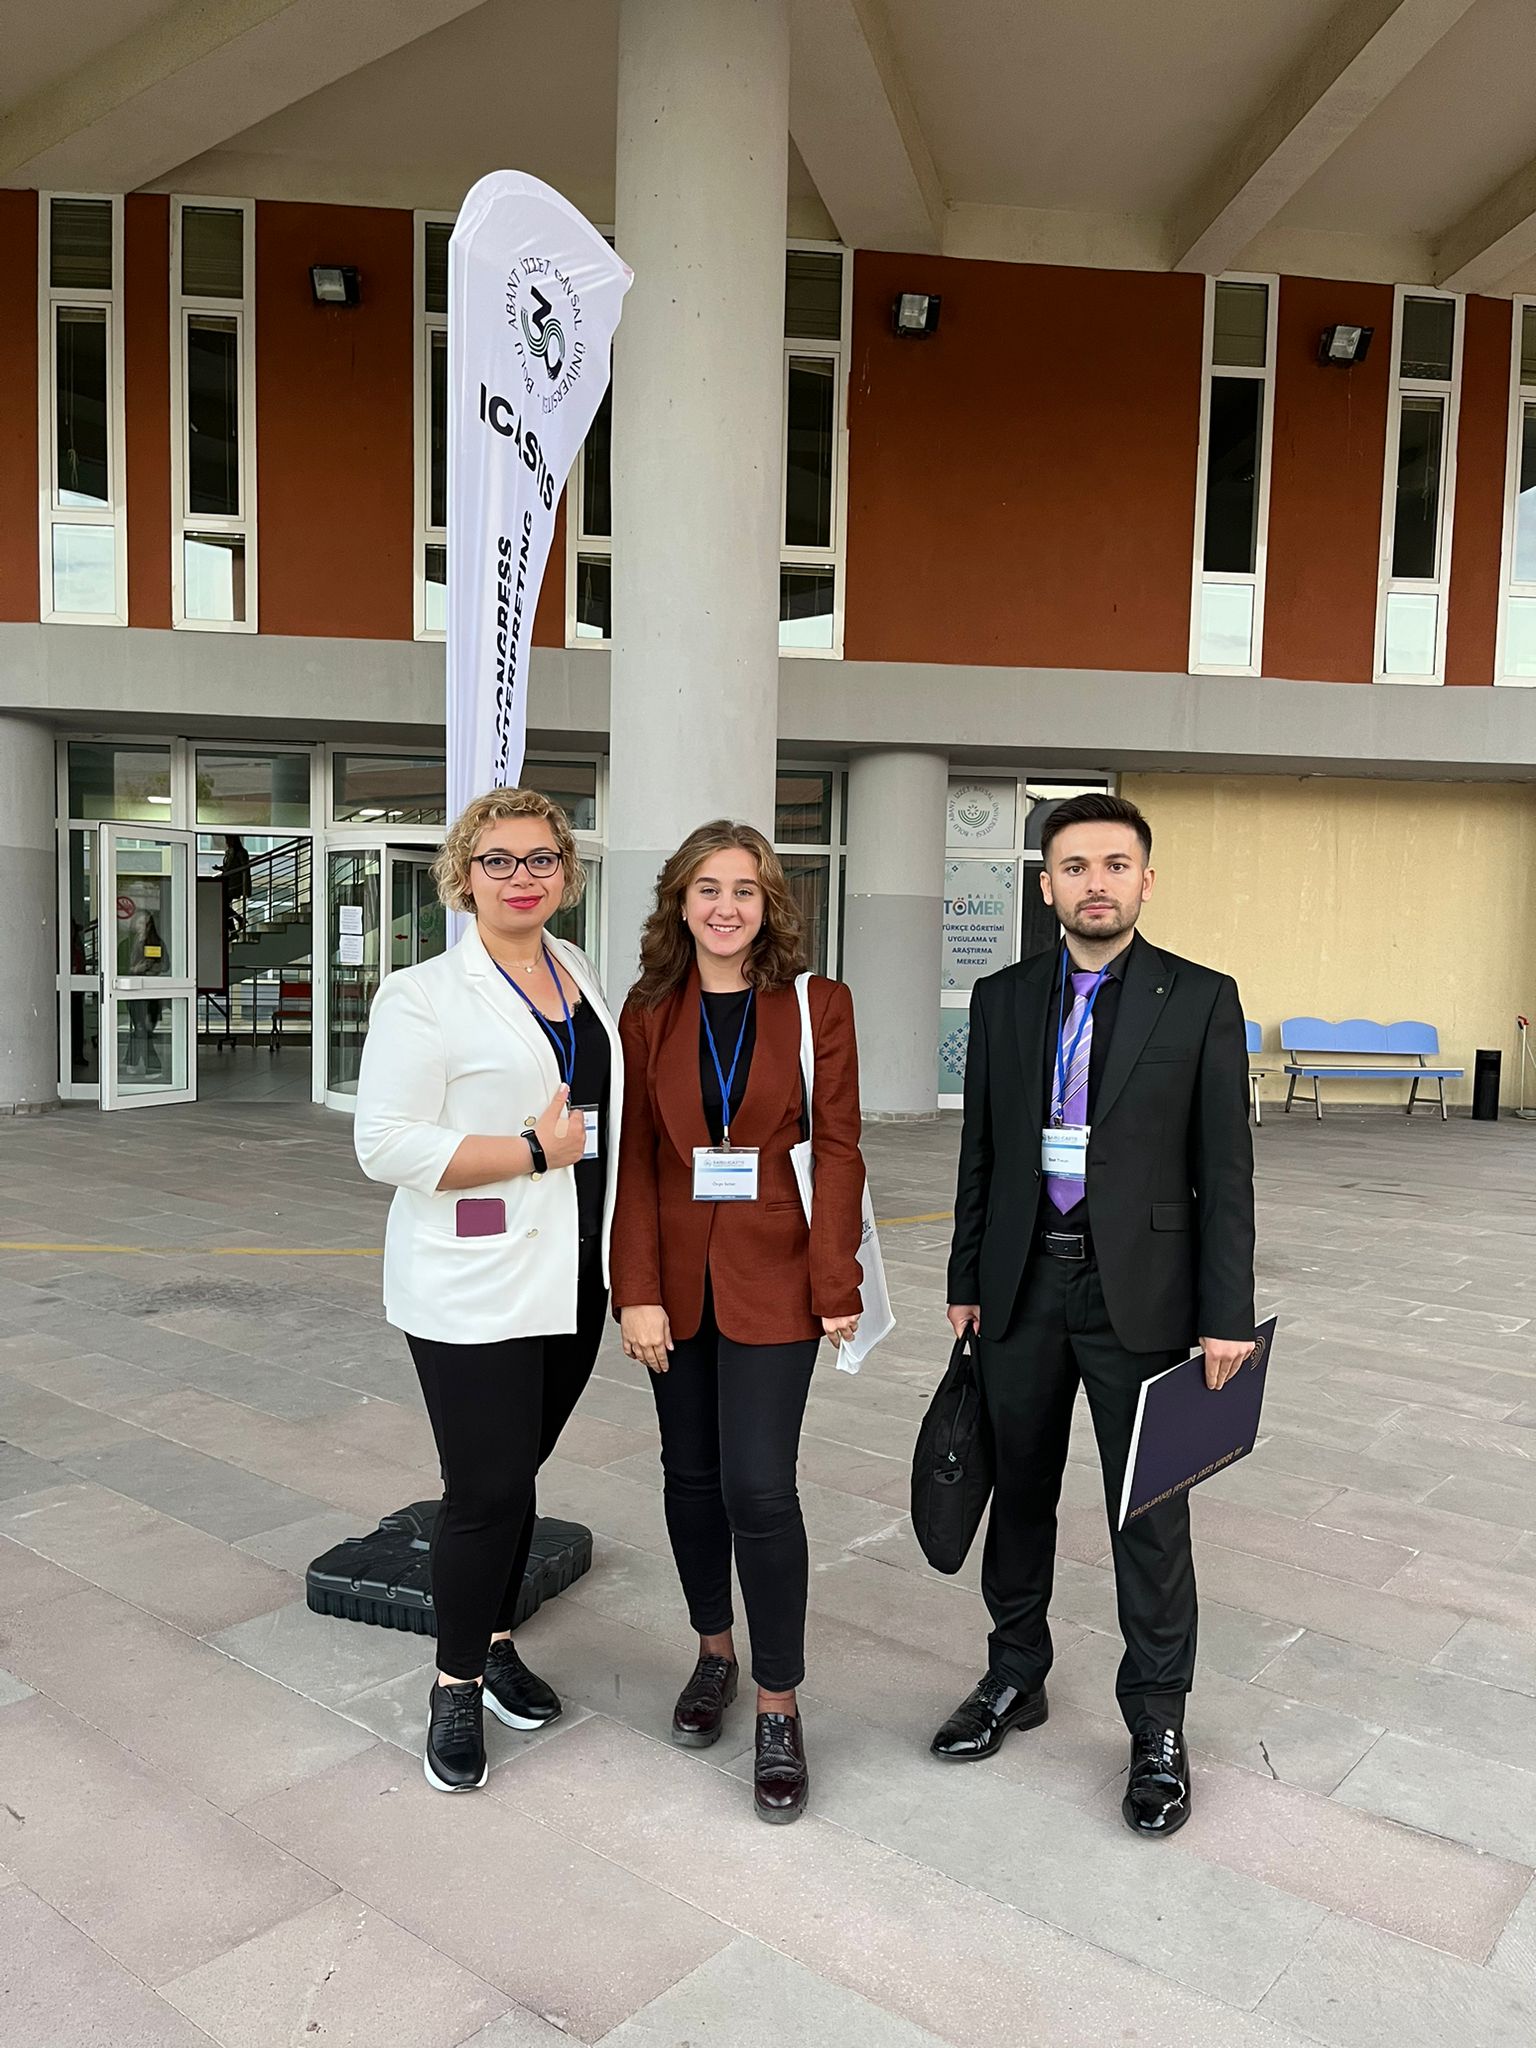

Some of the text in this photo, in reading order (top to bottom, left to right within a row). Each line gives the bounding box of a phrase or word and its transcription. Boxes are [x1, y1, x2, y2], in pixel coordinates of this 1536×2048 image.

[505, 268, 521, 330] ABANT
[944, 897, 1004, 916] TÖMER
[942, 924, 969, 932] TÜRKÇE
[952, 947, 993, 955] ARAŞTIRMA
[956, 957, 987, 965] MERKEZİ
